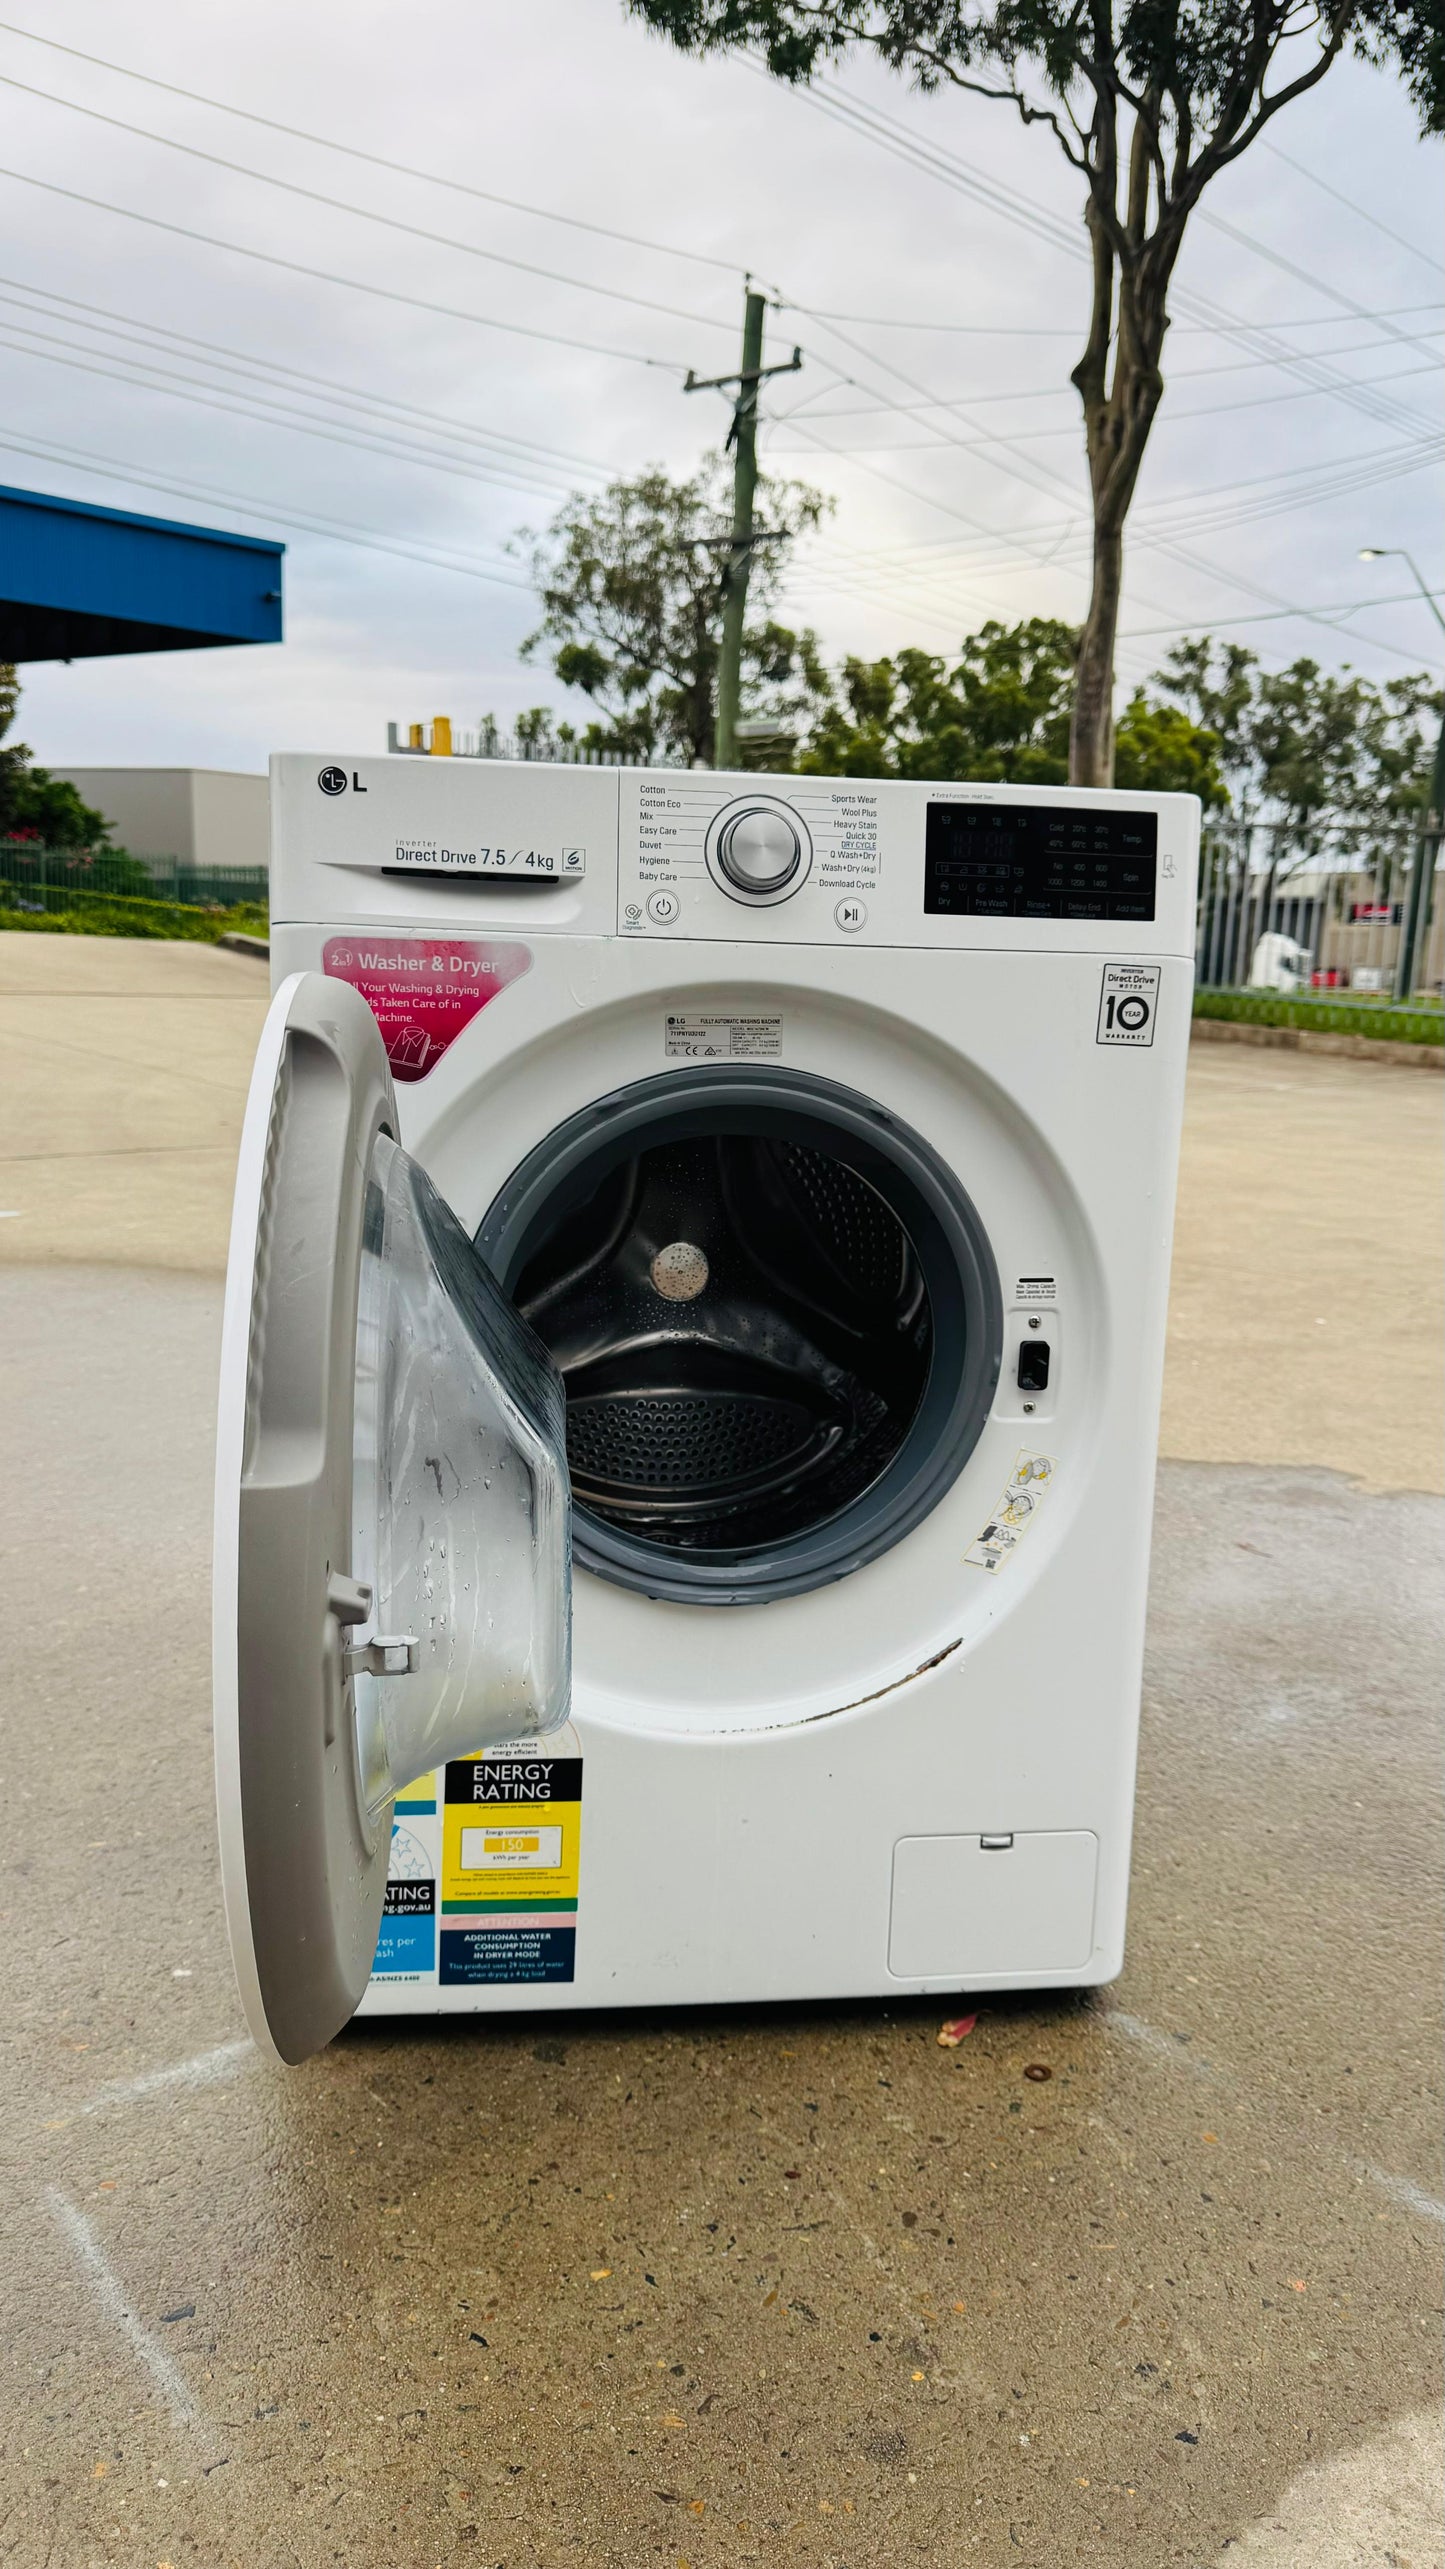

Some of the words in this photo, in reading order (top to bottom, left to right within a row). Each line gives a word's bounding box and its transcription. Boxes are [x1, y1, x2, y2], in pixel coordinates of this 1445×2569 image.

[640, 785, 666, 795] Cotton
[640, 798, 665, 808] Cotton
[667, 800, 681, 808] Eco
[831, 795, 856, 805] Sports
[858, 795, 877, 804] Wear
[639, 811, 653, 820] Mix
[841, 808, 859, 817] Wool
[862, 809, 877, 818] Plus
[834, 820, 856, 830] Heavy
[859, 821, 877, 830] Stain
[639, 826, 657, 837] Easy
[660, 827, 677, 835] Care
[845, 832, 865, 841] Quick
[867, 832, 877, 841] 30
[639, 841, 662, 850] Duvet
[841, 841, 854, 849] DRY
[856, 841, 876, 850] CYCLE
[395, 847, 438, 863] Direct
[440, 849, 477, 865] Drive
[480, 848, 506, 867] 7.5
[525, 850, 554, 871] 4kg
[639, 856, 670, 866] Hygiene
[830, 851, 836, 859] Q
[838, 851, 876, 861] Wash+Dry
[821, 864, 859, 874] Wash+Dry
[861, 865, 877, 874] (4kg)
[639, 872, 658, 882] Baby
[661, 873, 677, 881] Care
[819, 880, 854, 888] Download
[856, 880, 876, 890] Cycle
[358, 953, 426, 971] Washer
[432, 957, 444, 971] &
[450, 958, 499, 978] Dryer
[1108, 974, 1132, 983] Direct
[1133, 975, 1155, 984] Drive
[361, 983, 386, 993] Your
[388, 984, 433, 995] Washing
[436, 985, 443, 994] &
[446, 986, 480, 997] Drying
[380, 998, 409, 1008] Taken
[412, 999, 436, 1009] Care
[438, 999, 449, 1009] of
[452, 1000, 461, 1009] in
[1106, 996, 1149, 1031] 10
[473, 1764, 553, 1781] ENERGY
[473, 1783, 551, 1800] RATING
[502, 1839, 524, 1851] 150
[385, 1886, 430, 1900] TING
[478, 1917, 539, 1927] ATTENTION
[464, 1934, 519, 1942] ADDITIONAL
[520, 1933, 551, 1941] WATER
[397, 1938, 416, 1948] per
[474, 1942, 540, 1951] CONSUMPTION
[376, 1948, 394, 1958] ash
[485, 1951, 513, 1959] DRYER
[515, 1951, 540, 1959] MODE
